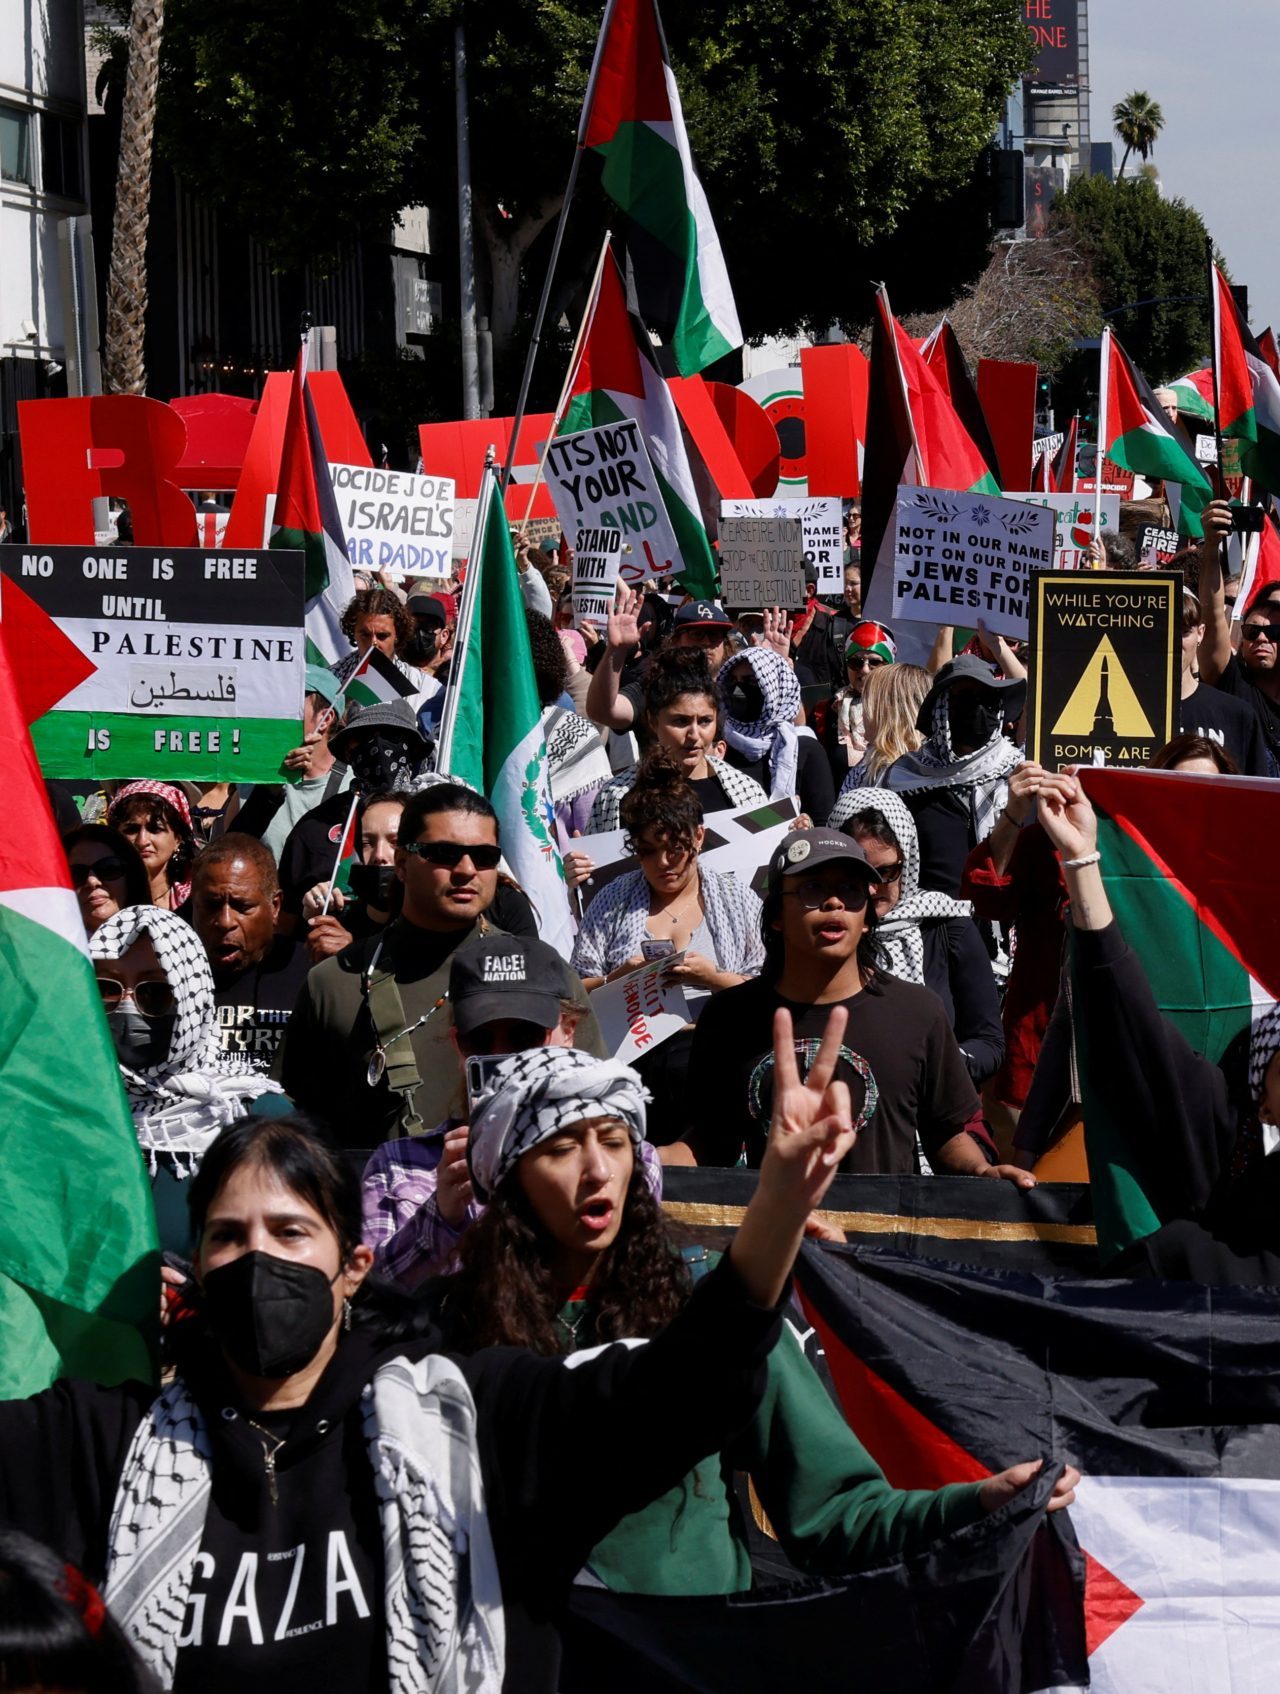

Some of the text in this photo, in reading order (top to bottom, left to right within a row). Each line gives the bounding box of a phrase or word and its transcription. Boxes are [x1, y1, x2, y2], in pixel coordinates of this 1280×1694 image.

[1026, 0, 1052, 19] HE
[546, 423, 640, 477] ITS NOT
[331, 467, 451, 501] OCIDE JOE
[560, 460, 647, 512] YOUR
[347, 499, 454, 538] ISRAEL'S
[576, 501, 658, 536] AND
[576, 528, 621, 554] STAND
[720, 521, 800, 543] CEASEFIRE NOW
[803, 526, 840, 536] NAME
[808, 538, 841, 547] DIME
[1144, 527, 1180, 542] CEASE
[899, 526, 935, 540] NOT
[943, 531, 960, 544] IN
[967, 535, 1002, 551] OUR
[1008, 542, 1050, 562] NAME
[1142, 536, 1178, 554] FIRE
[22, 555, 258, 580] NO ONE IS FREE
[378, 540, 449, 574] DADDY
[576, 557, 607, 579] WITH
[722, 551, 746, 573] STOP
[756, 550, 799, 573] GENOCIDE
[804, 551, 831, 563] OR
[898, 543, 1047, 575] NOT ON OUR DIM
[906, 560, 978, 586] JEWS
[726, 580, 750, 599] FREE
[897, 580, 1030, 620] PALESTIN
[1046, 593, 1168, 609] WHILE YOU'RE
[102, 595, 166, 621] UNTIL
[574, 599, 609, 615] LESTIN
[1058, 613, 1155, 628] WATCHING
[91, 631, 294, 662] PALESTINE
[130, 671, 237, 708] فلسطين
[87, 728, 111, 751] IS
[1117, 746, 1151, 760] ARE
[818, 840, 848, 848] HOCKEY
[484, 954, 520, 971] FACE
[483, 970, 526, 981] NATION
[217, 1005, 293, 1027] OR THE
[221, 1028, 284, 1051] TYRS
[176, 1530, 371, 1648] GAZA
[284, 1619, 324, 1638] RESILIENCE
